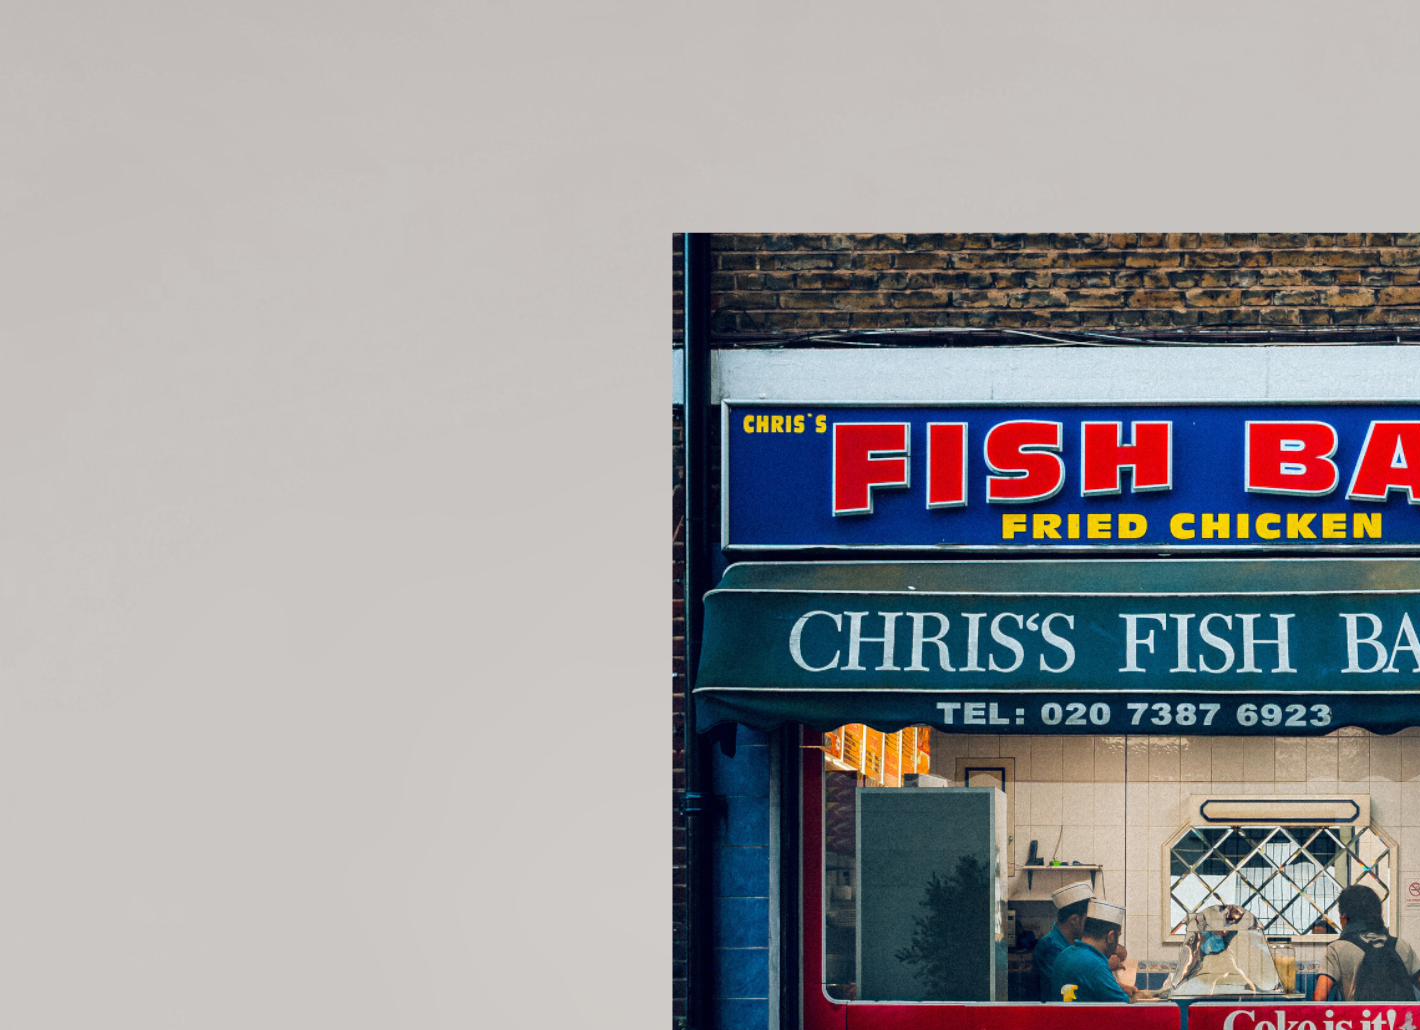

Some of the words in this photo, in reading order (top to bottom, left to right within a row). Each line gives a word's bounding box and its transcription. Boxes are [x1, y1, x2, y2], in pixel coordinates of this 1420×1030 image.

[832, 420, 1173, 516] FISH
[1002, 513, 1148, 539] FRIED
[1169, 512, 1383, 540] CHICKEN
[1118, 612, 1297, 674] FISH
[936, 702, 1026, 725] TEL:
[1040, 702, 1111, 725] 020
[1126, 703, 1221, 726] 7387
[1236, 703, 1332, 727] 6923
